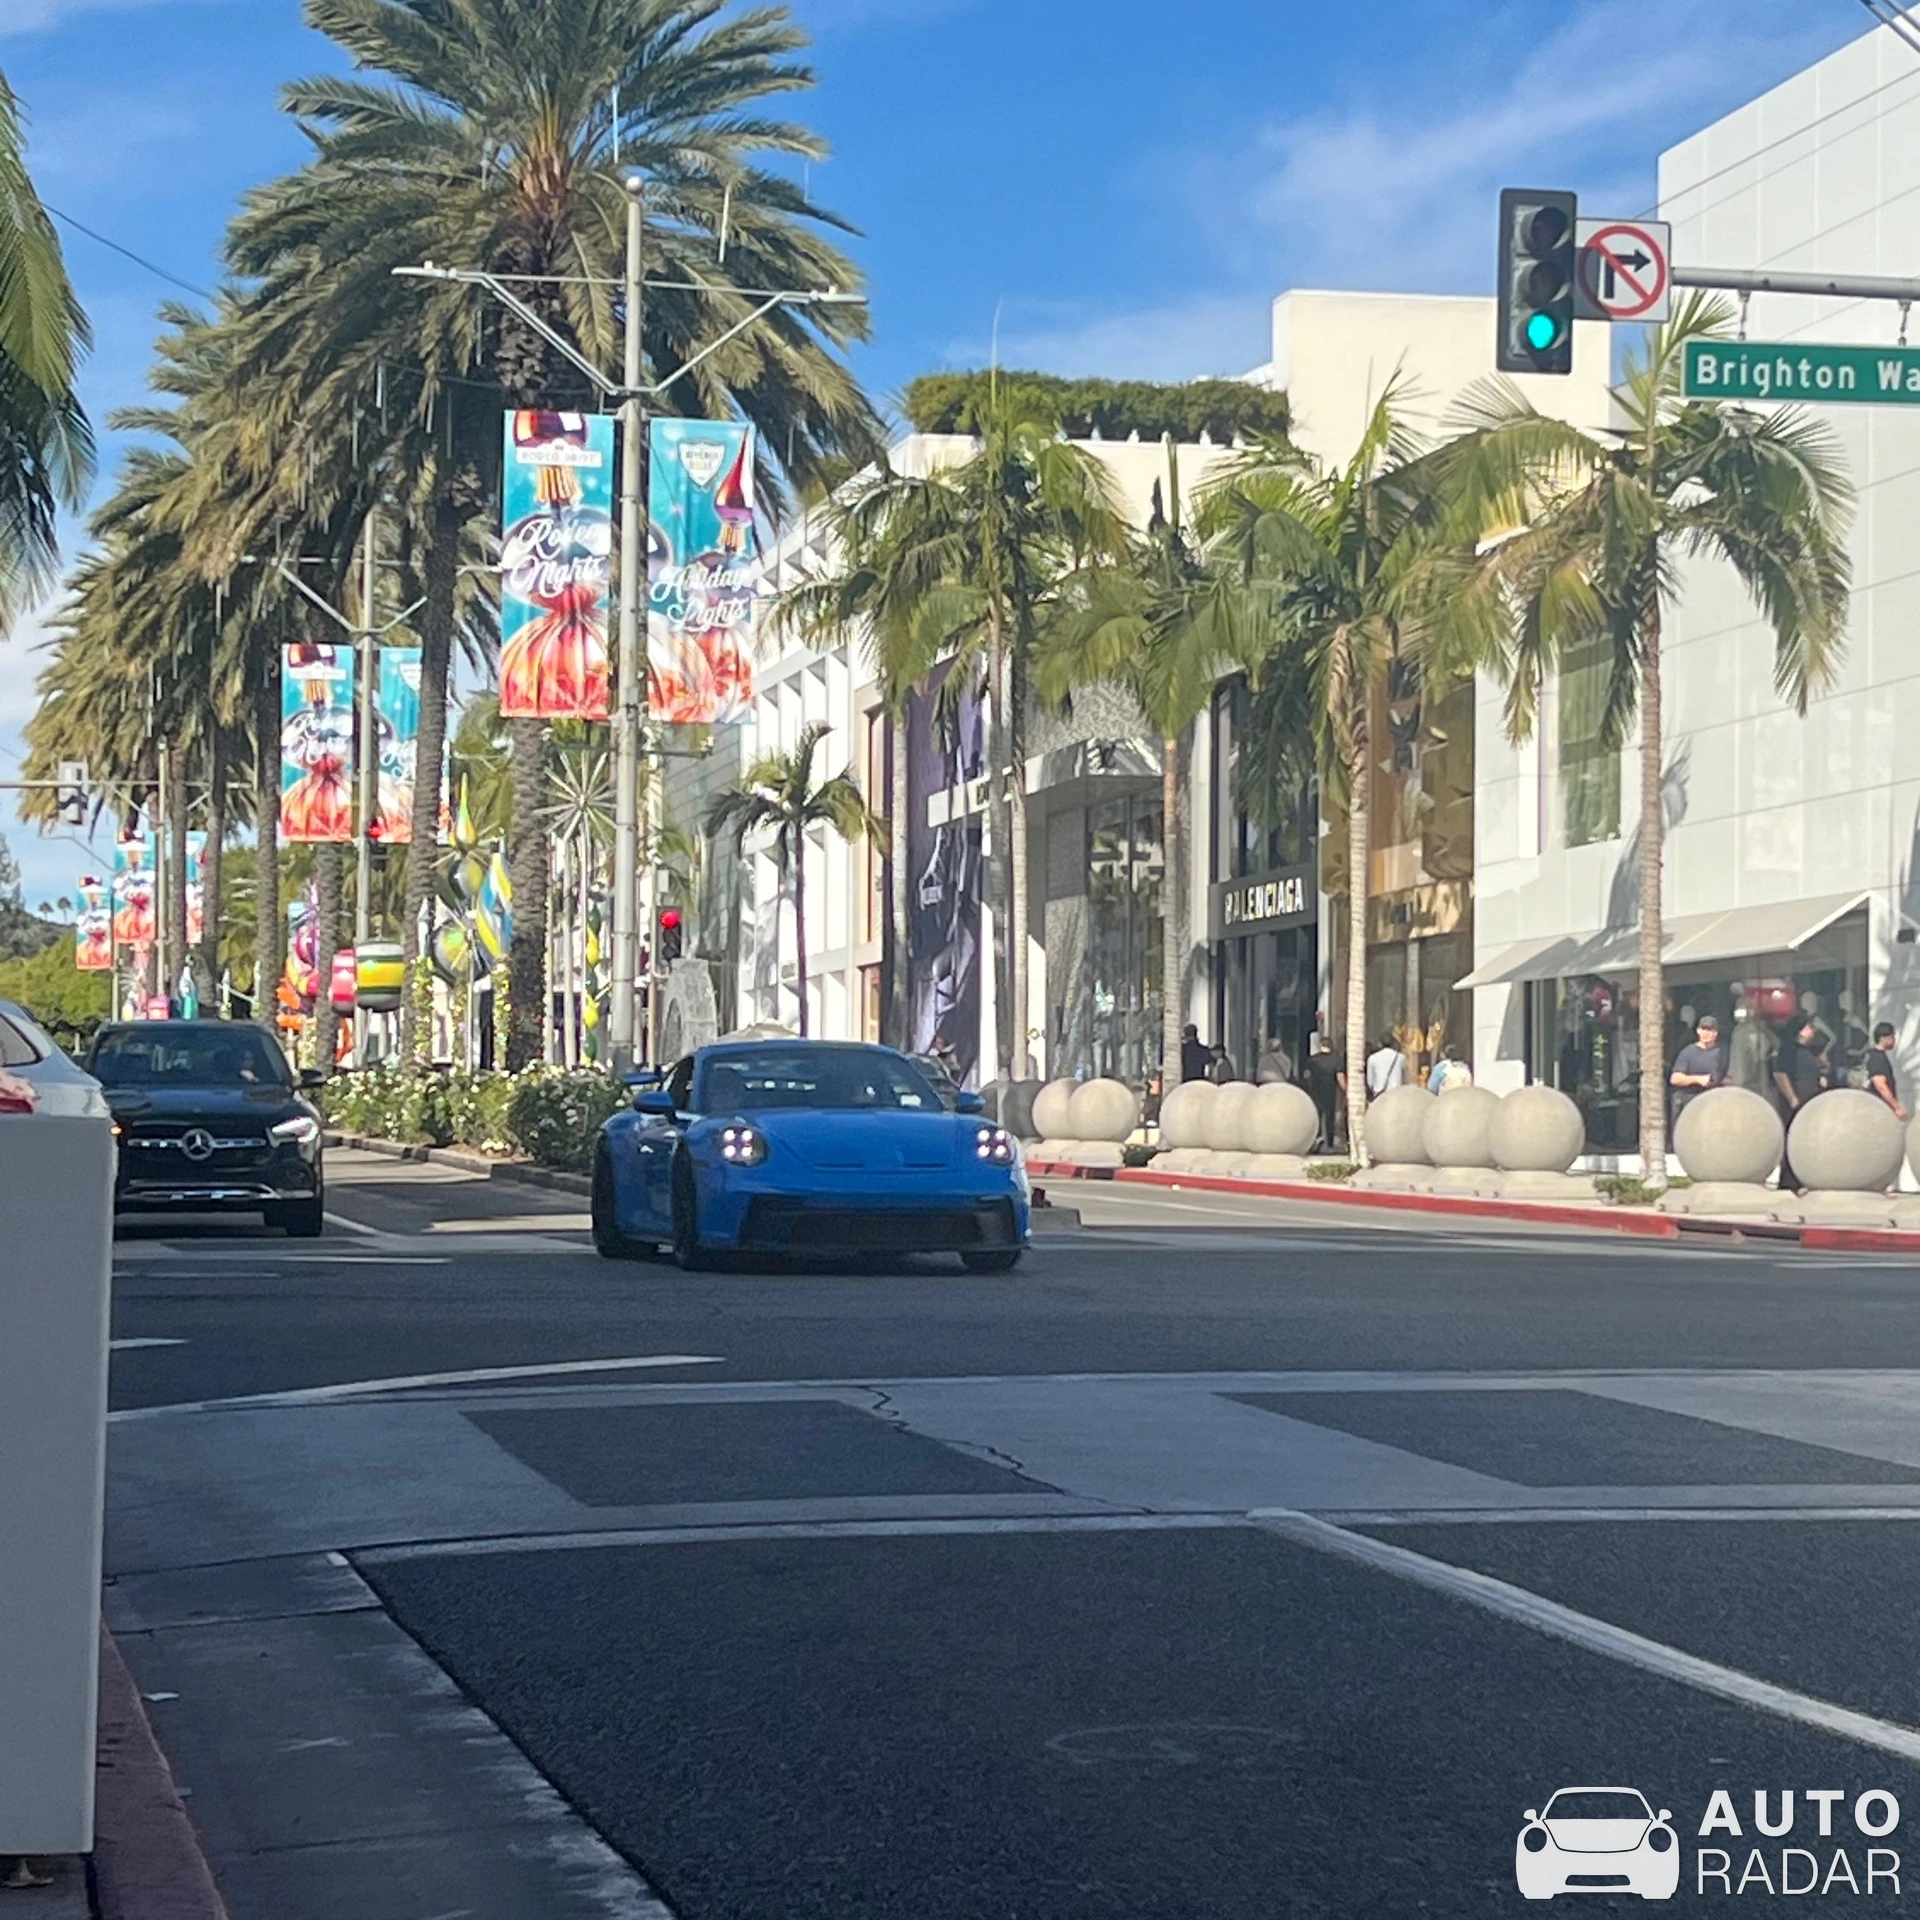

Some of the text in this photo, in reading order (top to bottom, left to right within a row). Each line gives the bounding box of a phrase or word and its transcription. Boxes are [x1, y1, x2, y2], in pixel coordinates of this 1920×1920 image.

[1697, 353, 1920, 397] Brighton Wa
[510, 555, 608, 598] Nights
[667, 597, 749, 632] Lights
[1224, 877, 1304, 925] BALENCIAGA
